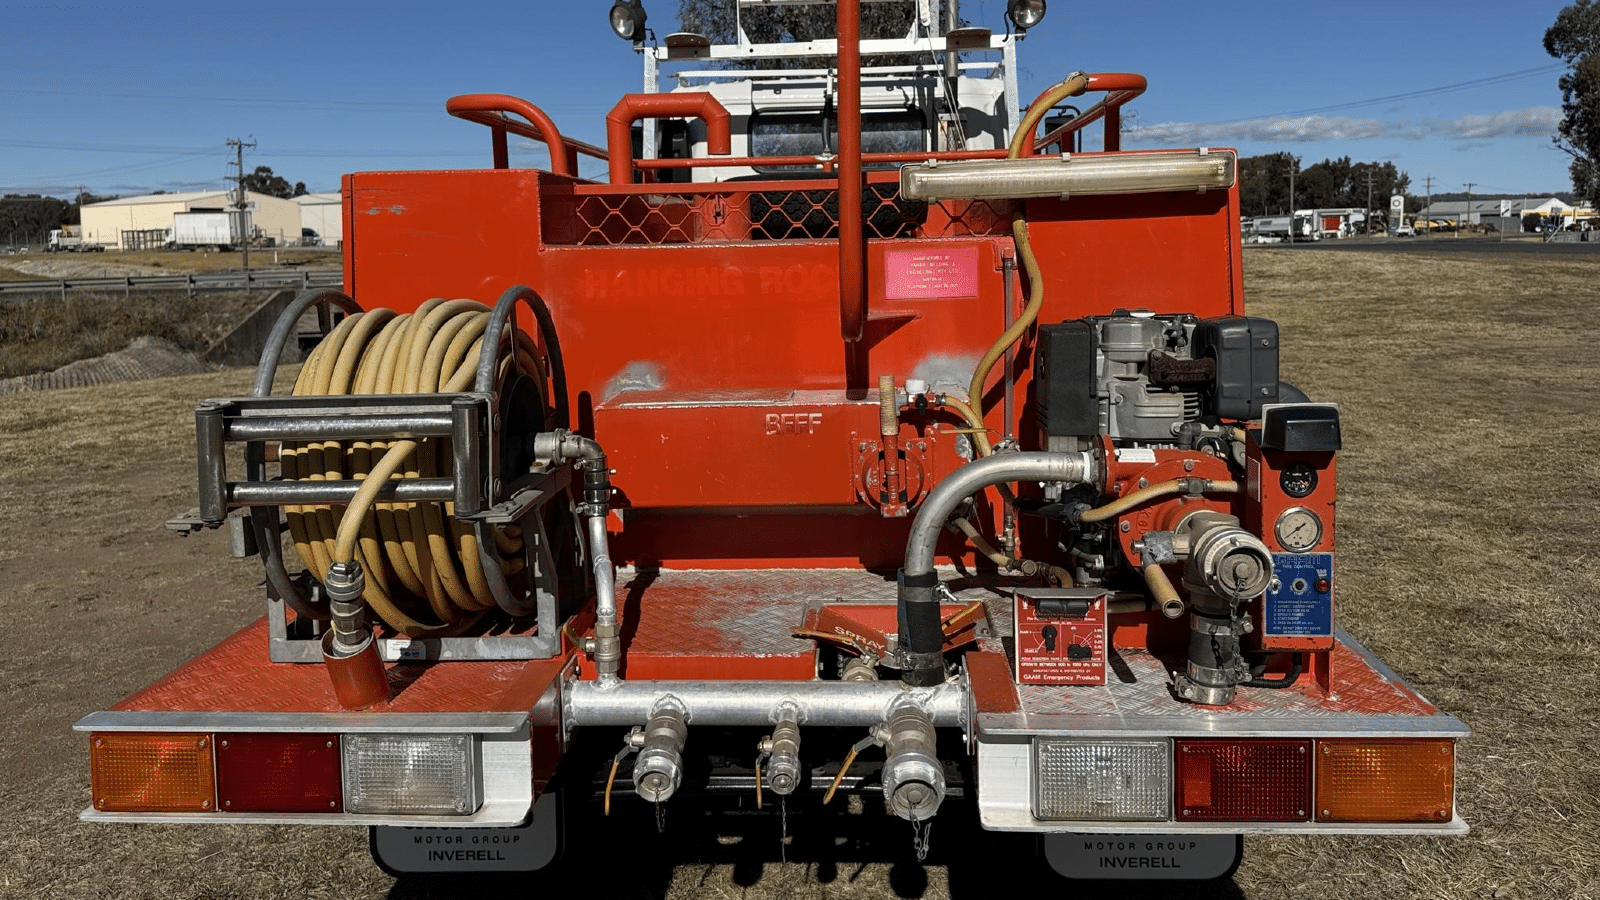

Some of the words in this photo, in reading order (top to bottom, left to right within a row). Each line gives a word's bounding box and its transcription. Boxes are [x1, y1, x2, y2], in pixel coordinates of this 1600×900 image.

[760, 264, 839, 295] ROC
[834, 626, 886, 650] SPRAY
[414, 835, 463, 844] MOTOR
[472, 835, 521, 844] GROUP
[1084, 841, 1136, 850] MOTOR
[1146, 841, 1196, 850] GROUP
[428, 850, 506, 861] INVERELL
[1100, 857, 1180, 868] INVERELL
